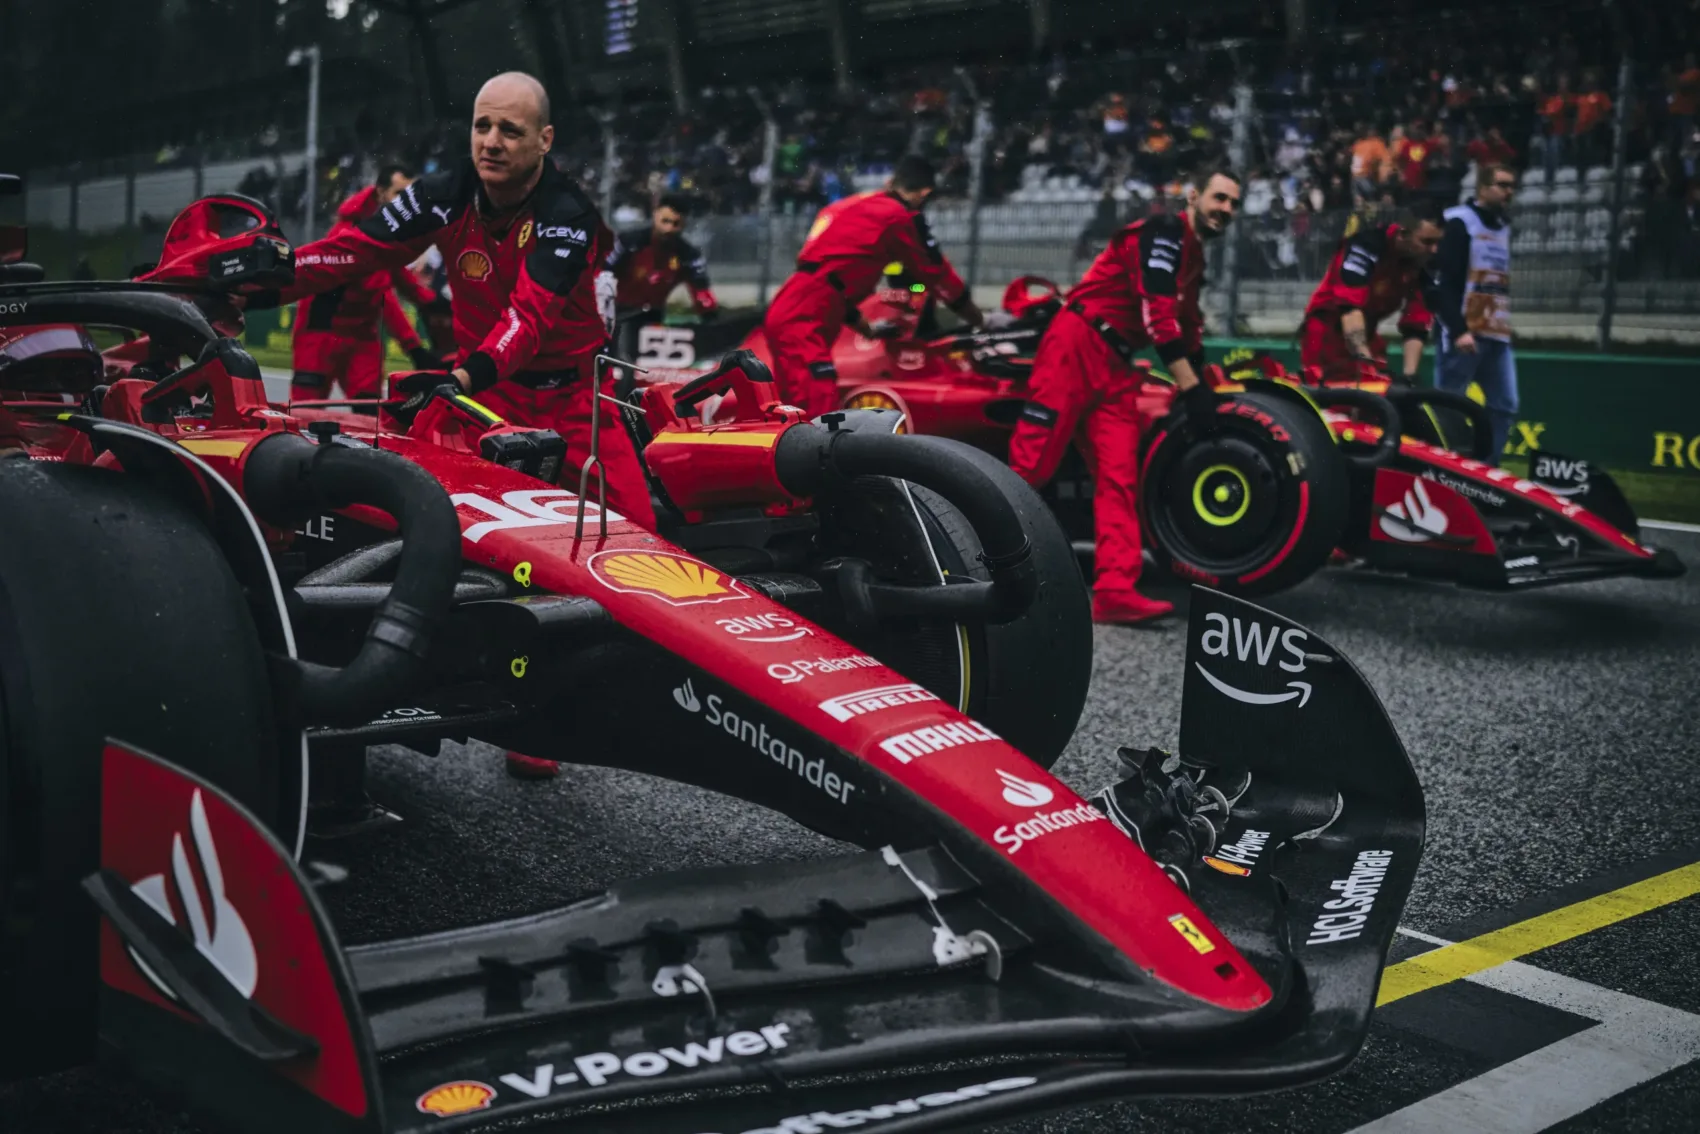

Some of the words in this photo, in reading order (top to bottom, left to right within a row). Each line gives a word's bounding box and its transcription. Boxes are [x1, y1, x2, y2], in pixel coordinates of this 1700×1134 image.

[322, 254, 355, 265] MILLE
[637, 326, 695, 370] 55
[1535, 457, 1589, 483] aws
[294, 515, 334, 542] LE
[449, 489, 627, 544] 16
[715, 613, 794, 634] aws
[1200, 612, 1309, 674] aws
[383, 707, 436, 718] OL
[705, 694, 856, 805] Santander
[993, 802, 1107, 854] Santande
[1215, 829, 1271, 865] V-Power
[500, 1022, 791, 1099] V-Power
